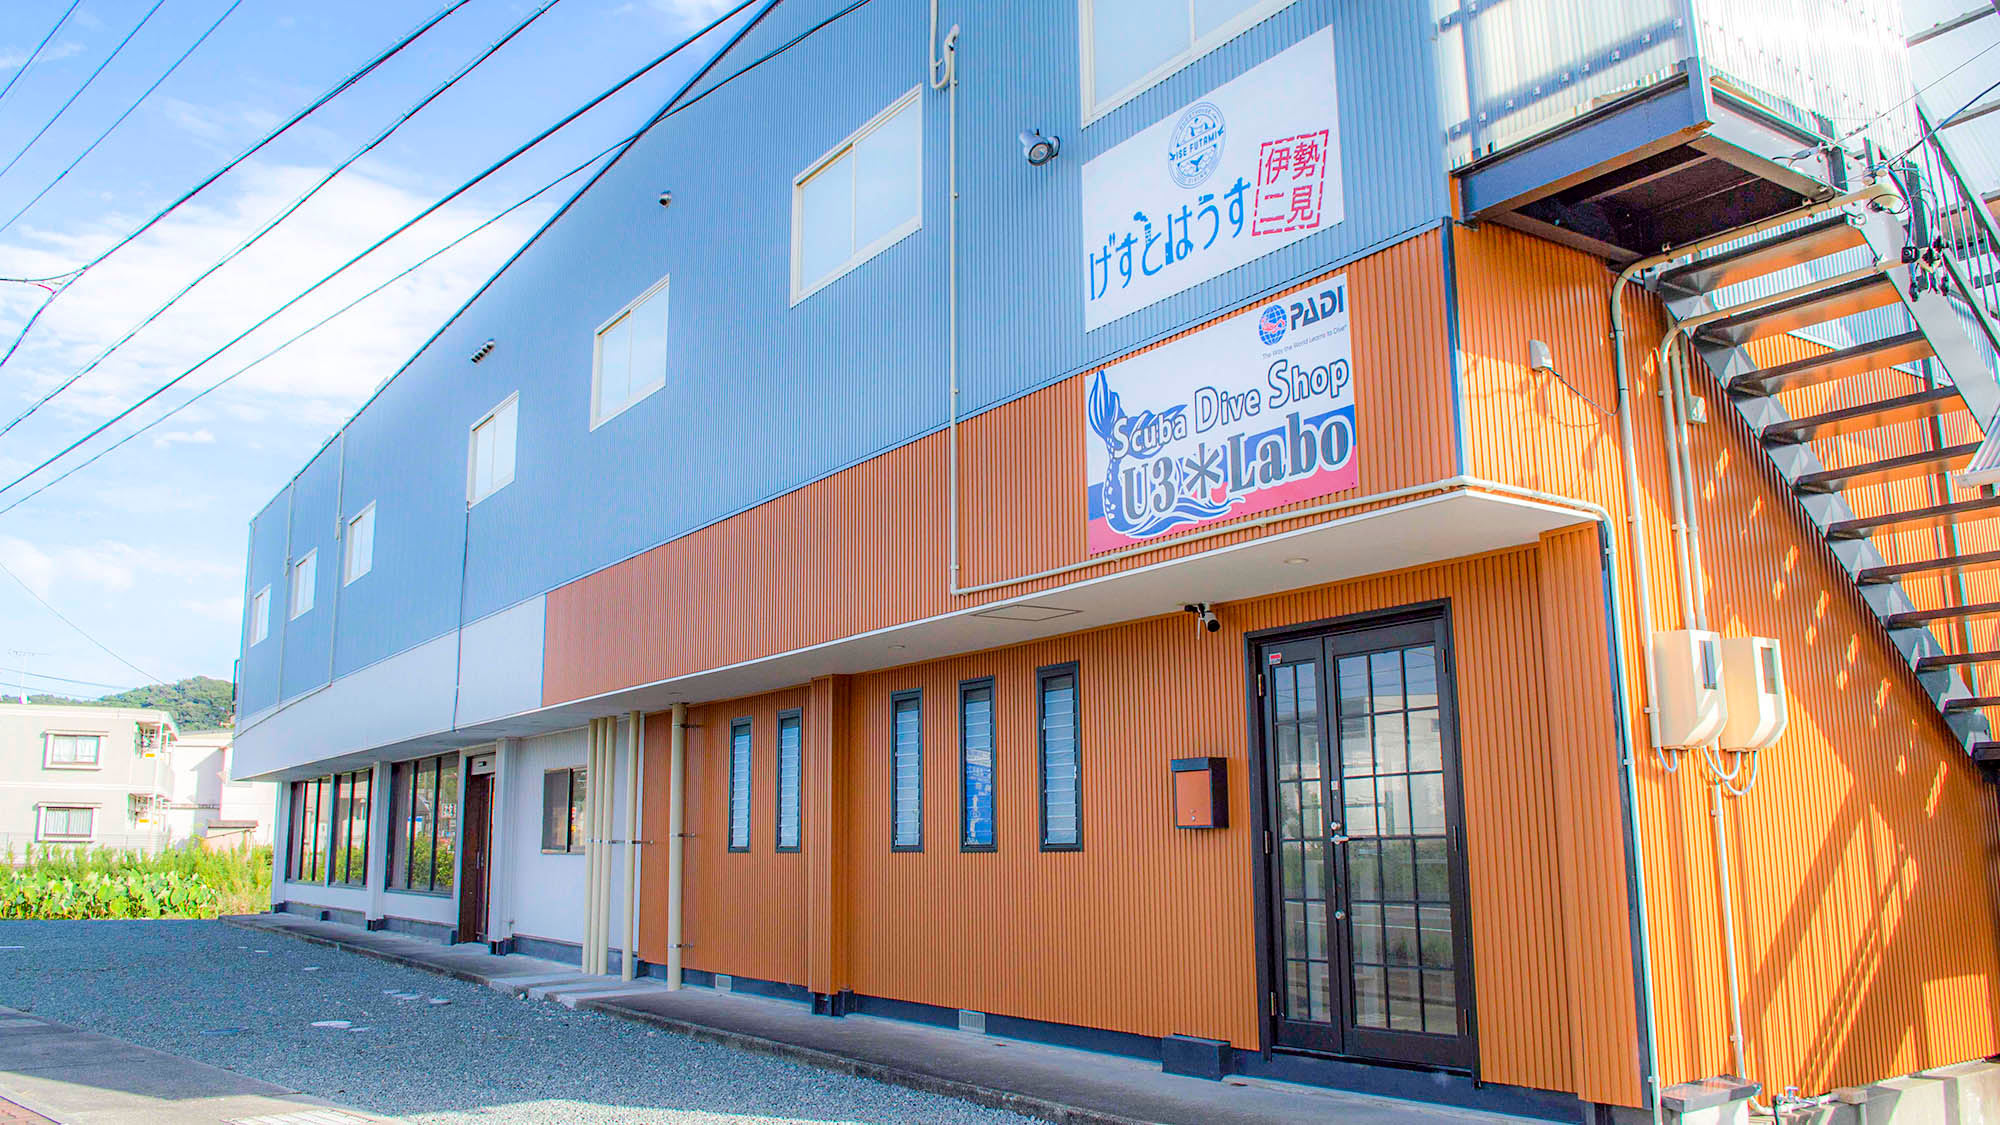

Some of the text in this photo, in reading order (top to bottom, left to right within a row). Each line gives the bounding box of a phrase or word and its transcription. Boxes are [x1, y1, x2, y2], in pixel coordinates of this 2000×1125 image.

[1175, 130, 1218, 160] ISE FUTAMI
[1265, 139, 1320, 185] 伊勢
[1259, 184, 1314, 224] 二見
[1089, 177, 1251, 301] げすとはうす
[1290, 285, 1344, 331] PADI
[1112, 359, 1349, 459] Scuba Dive Shop
